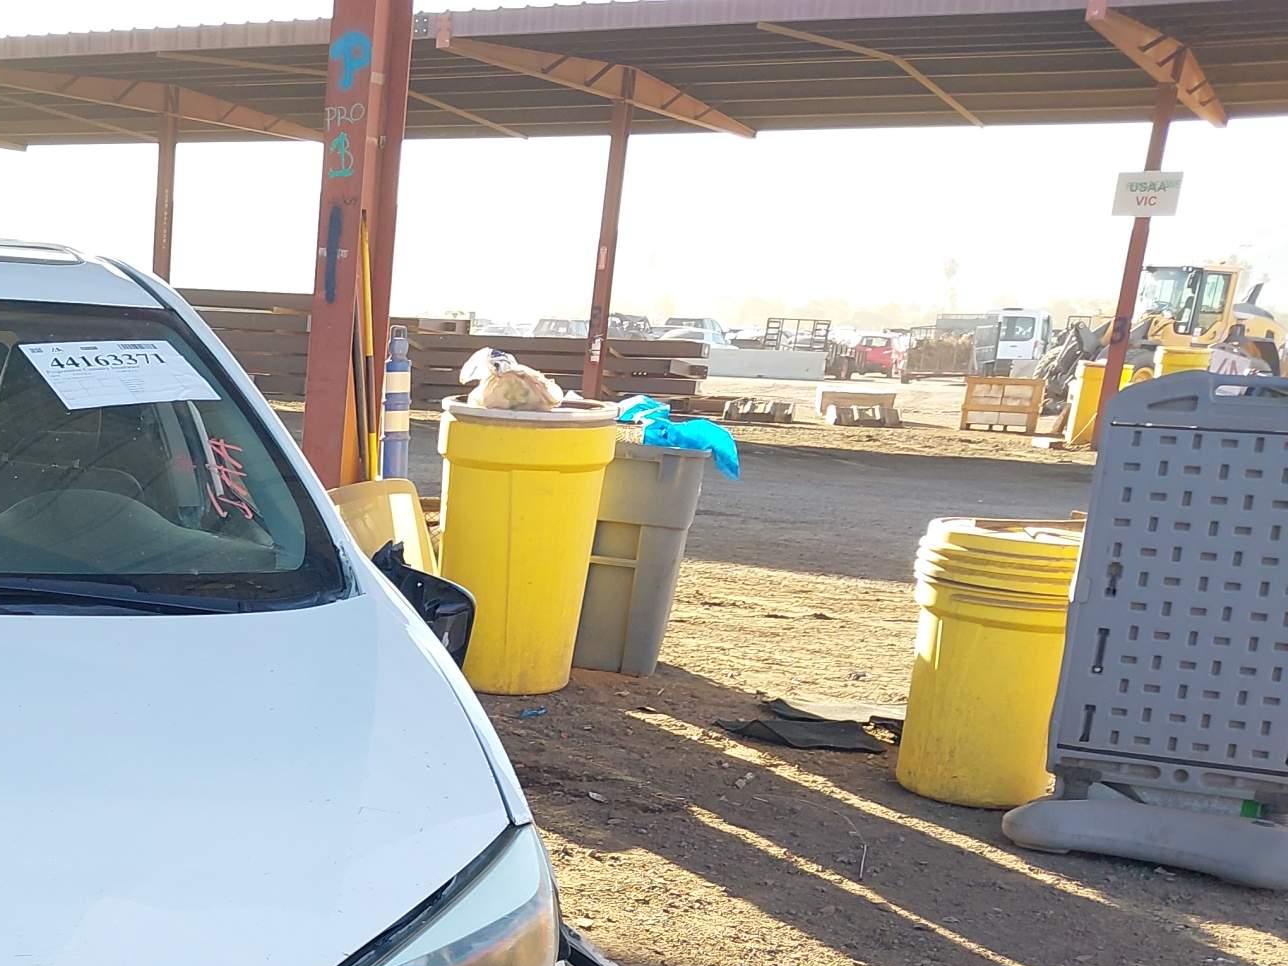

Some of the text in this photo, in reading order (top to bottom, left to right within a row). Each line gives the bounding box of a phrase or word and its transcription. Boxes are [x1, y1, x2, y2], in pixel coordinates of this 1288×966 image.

[324, 103, 366, 131] PRO
[1136, 195, 1158, 207] VIC
[50, 352, 167, 370] 44163371
